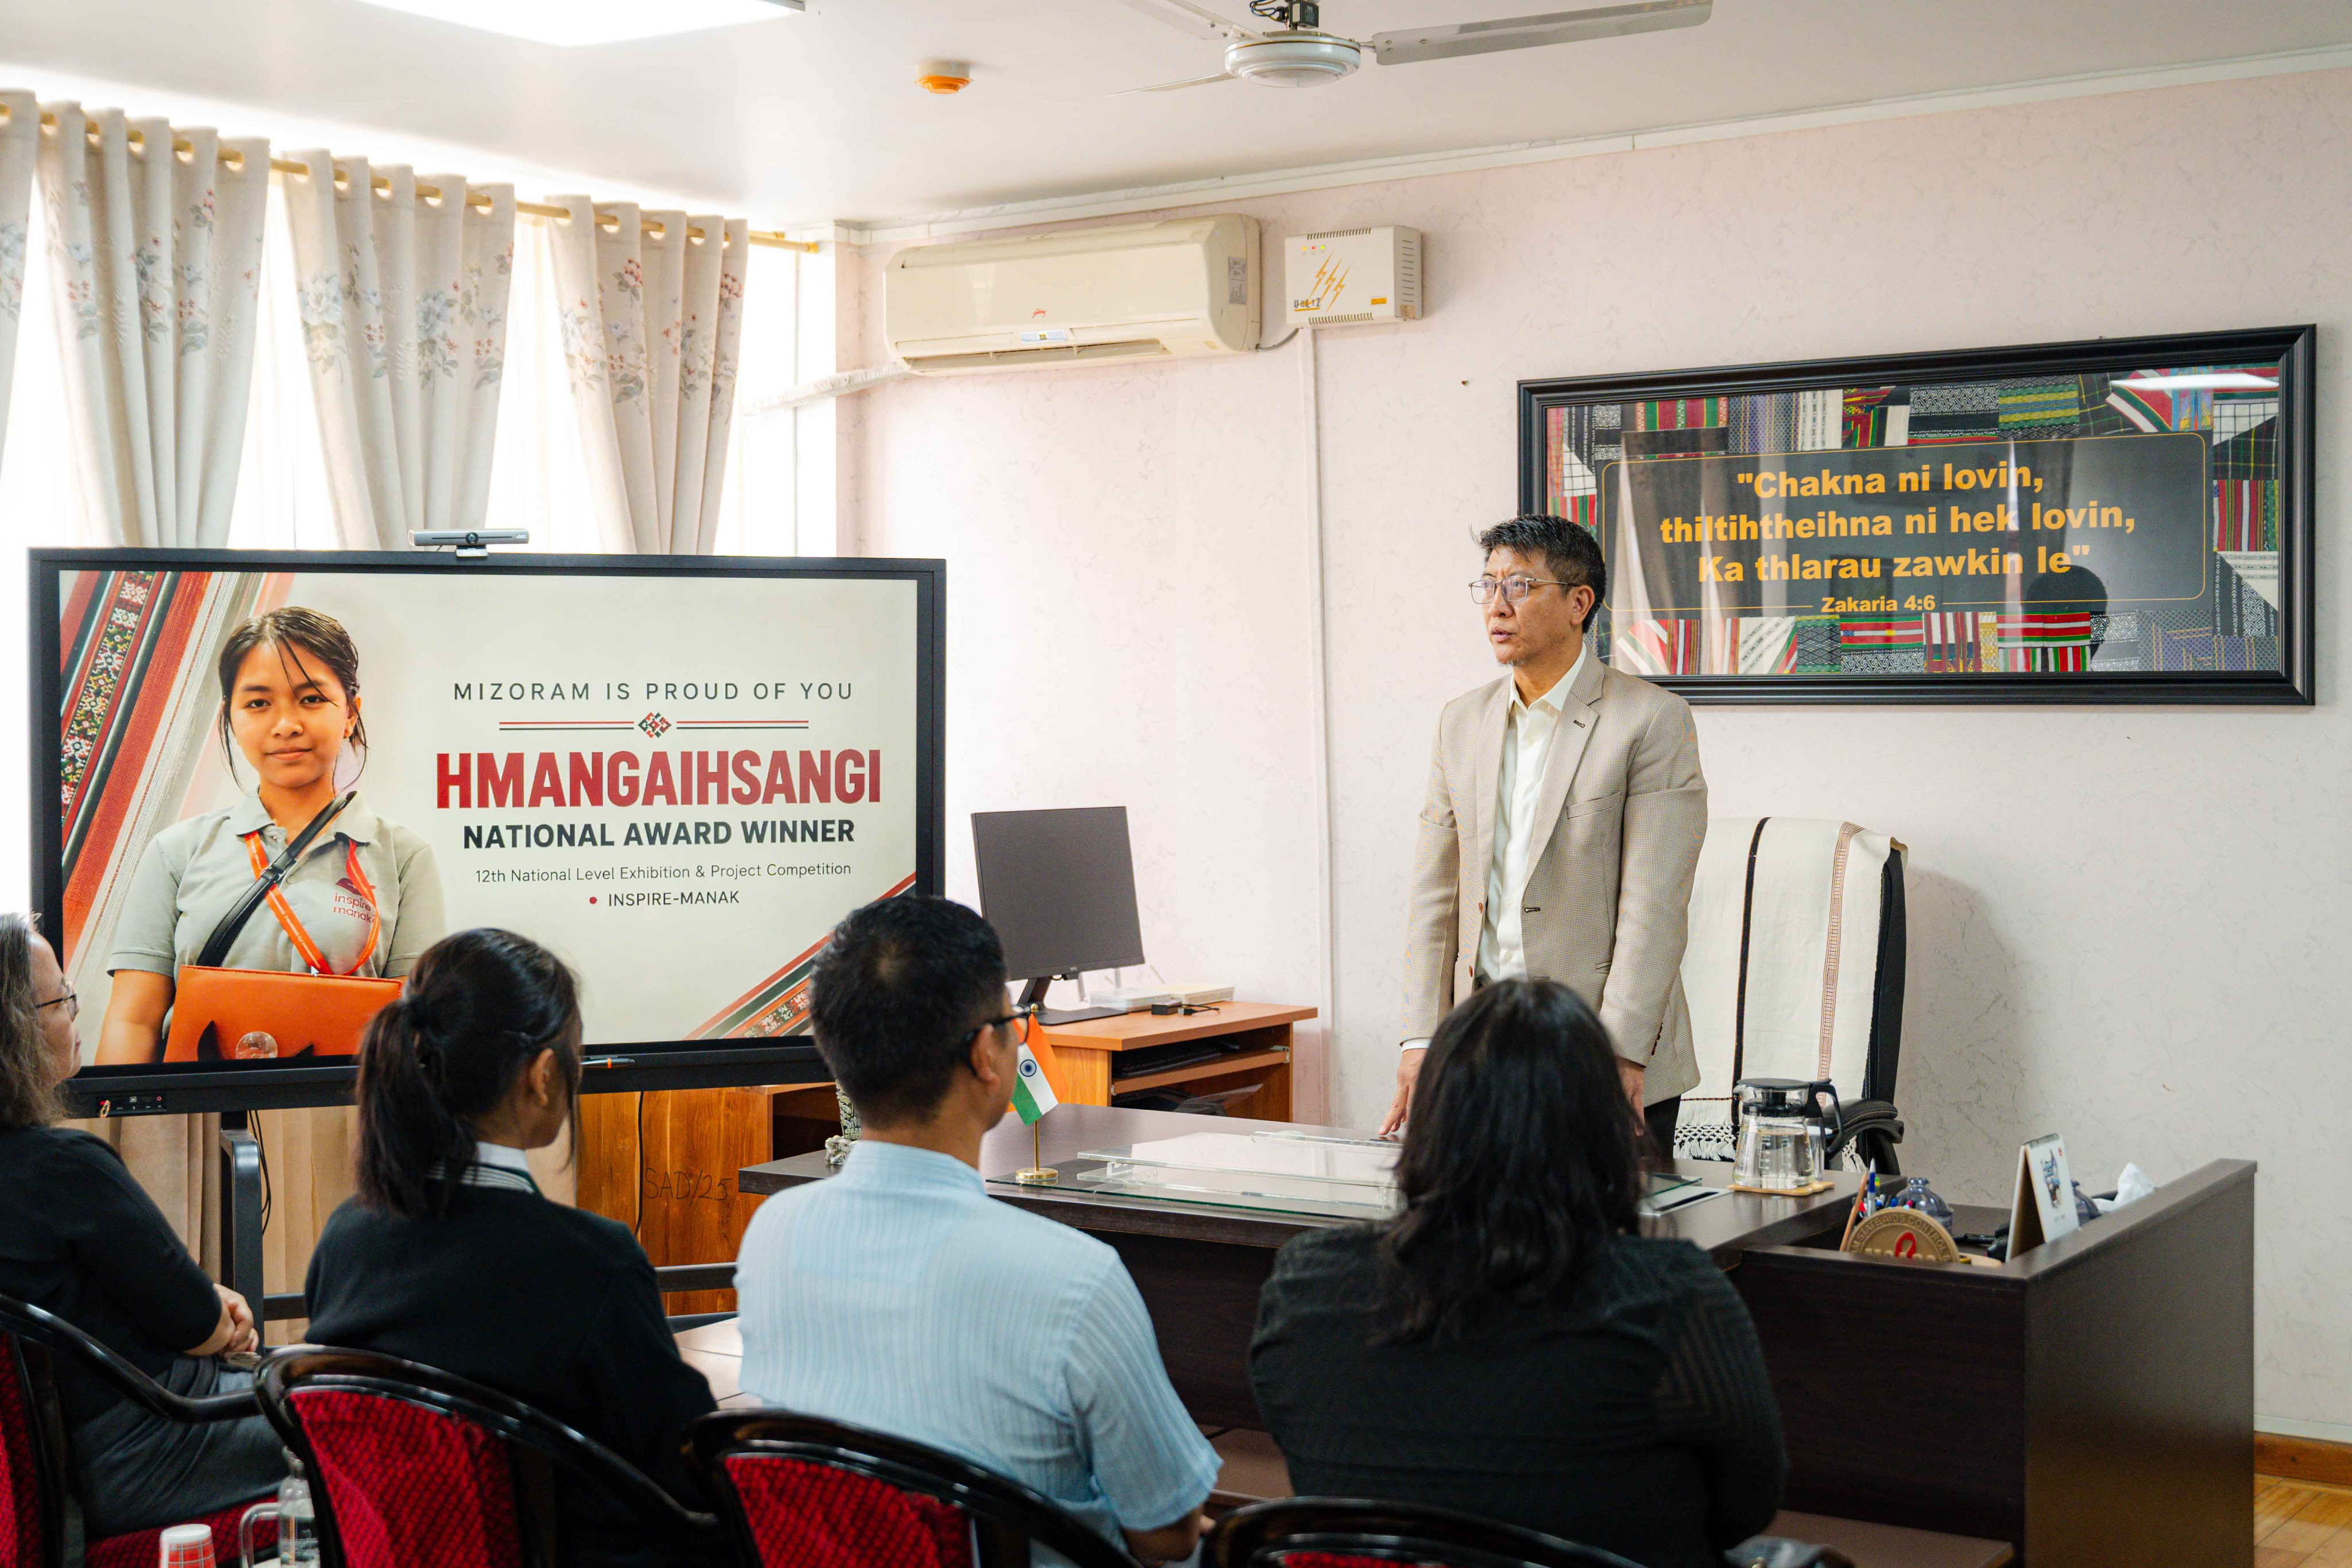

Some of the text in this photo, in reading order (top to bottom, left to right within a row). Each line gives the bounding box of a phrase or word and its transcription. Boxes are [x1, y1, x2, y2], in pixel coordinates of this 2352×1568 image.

[1736, 460, 2043, 498] "Chakna ni lovin,
[1659, 500, 2136, 544] thiltihtheihna ni hek lovin,
[1698, 545, 2090, 582] Ka thlarau zawkin le"
[1821, 595, 1936, 613] Zakaria 4:6
[454, 683, 852, 700] MIZORAM IS PROUD OF YOU
[436, 749, 881, 809] HMANGAIHSANGI
[463, 819, 854, 849] NATIONAL AWARD WINNER
[475, 862, 852, 882] 12th National Level Exhibition & Project Competition
[334, 893, 372, 912] inspire
[608, 891, 740, 907] INSPIRE-MANAK
[644, 1168, 733, 1207] SAD/25
[1859, 1217, 1881, 1241] STATE
[1882, 1213, 1906, 1225] AIDS
